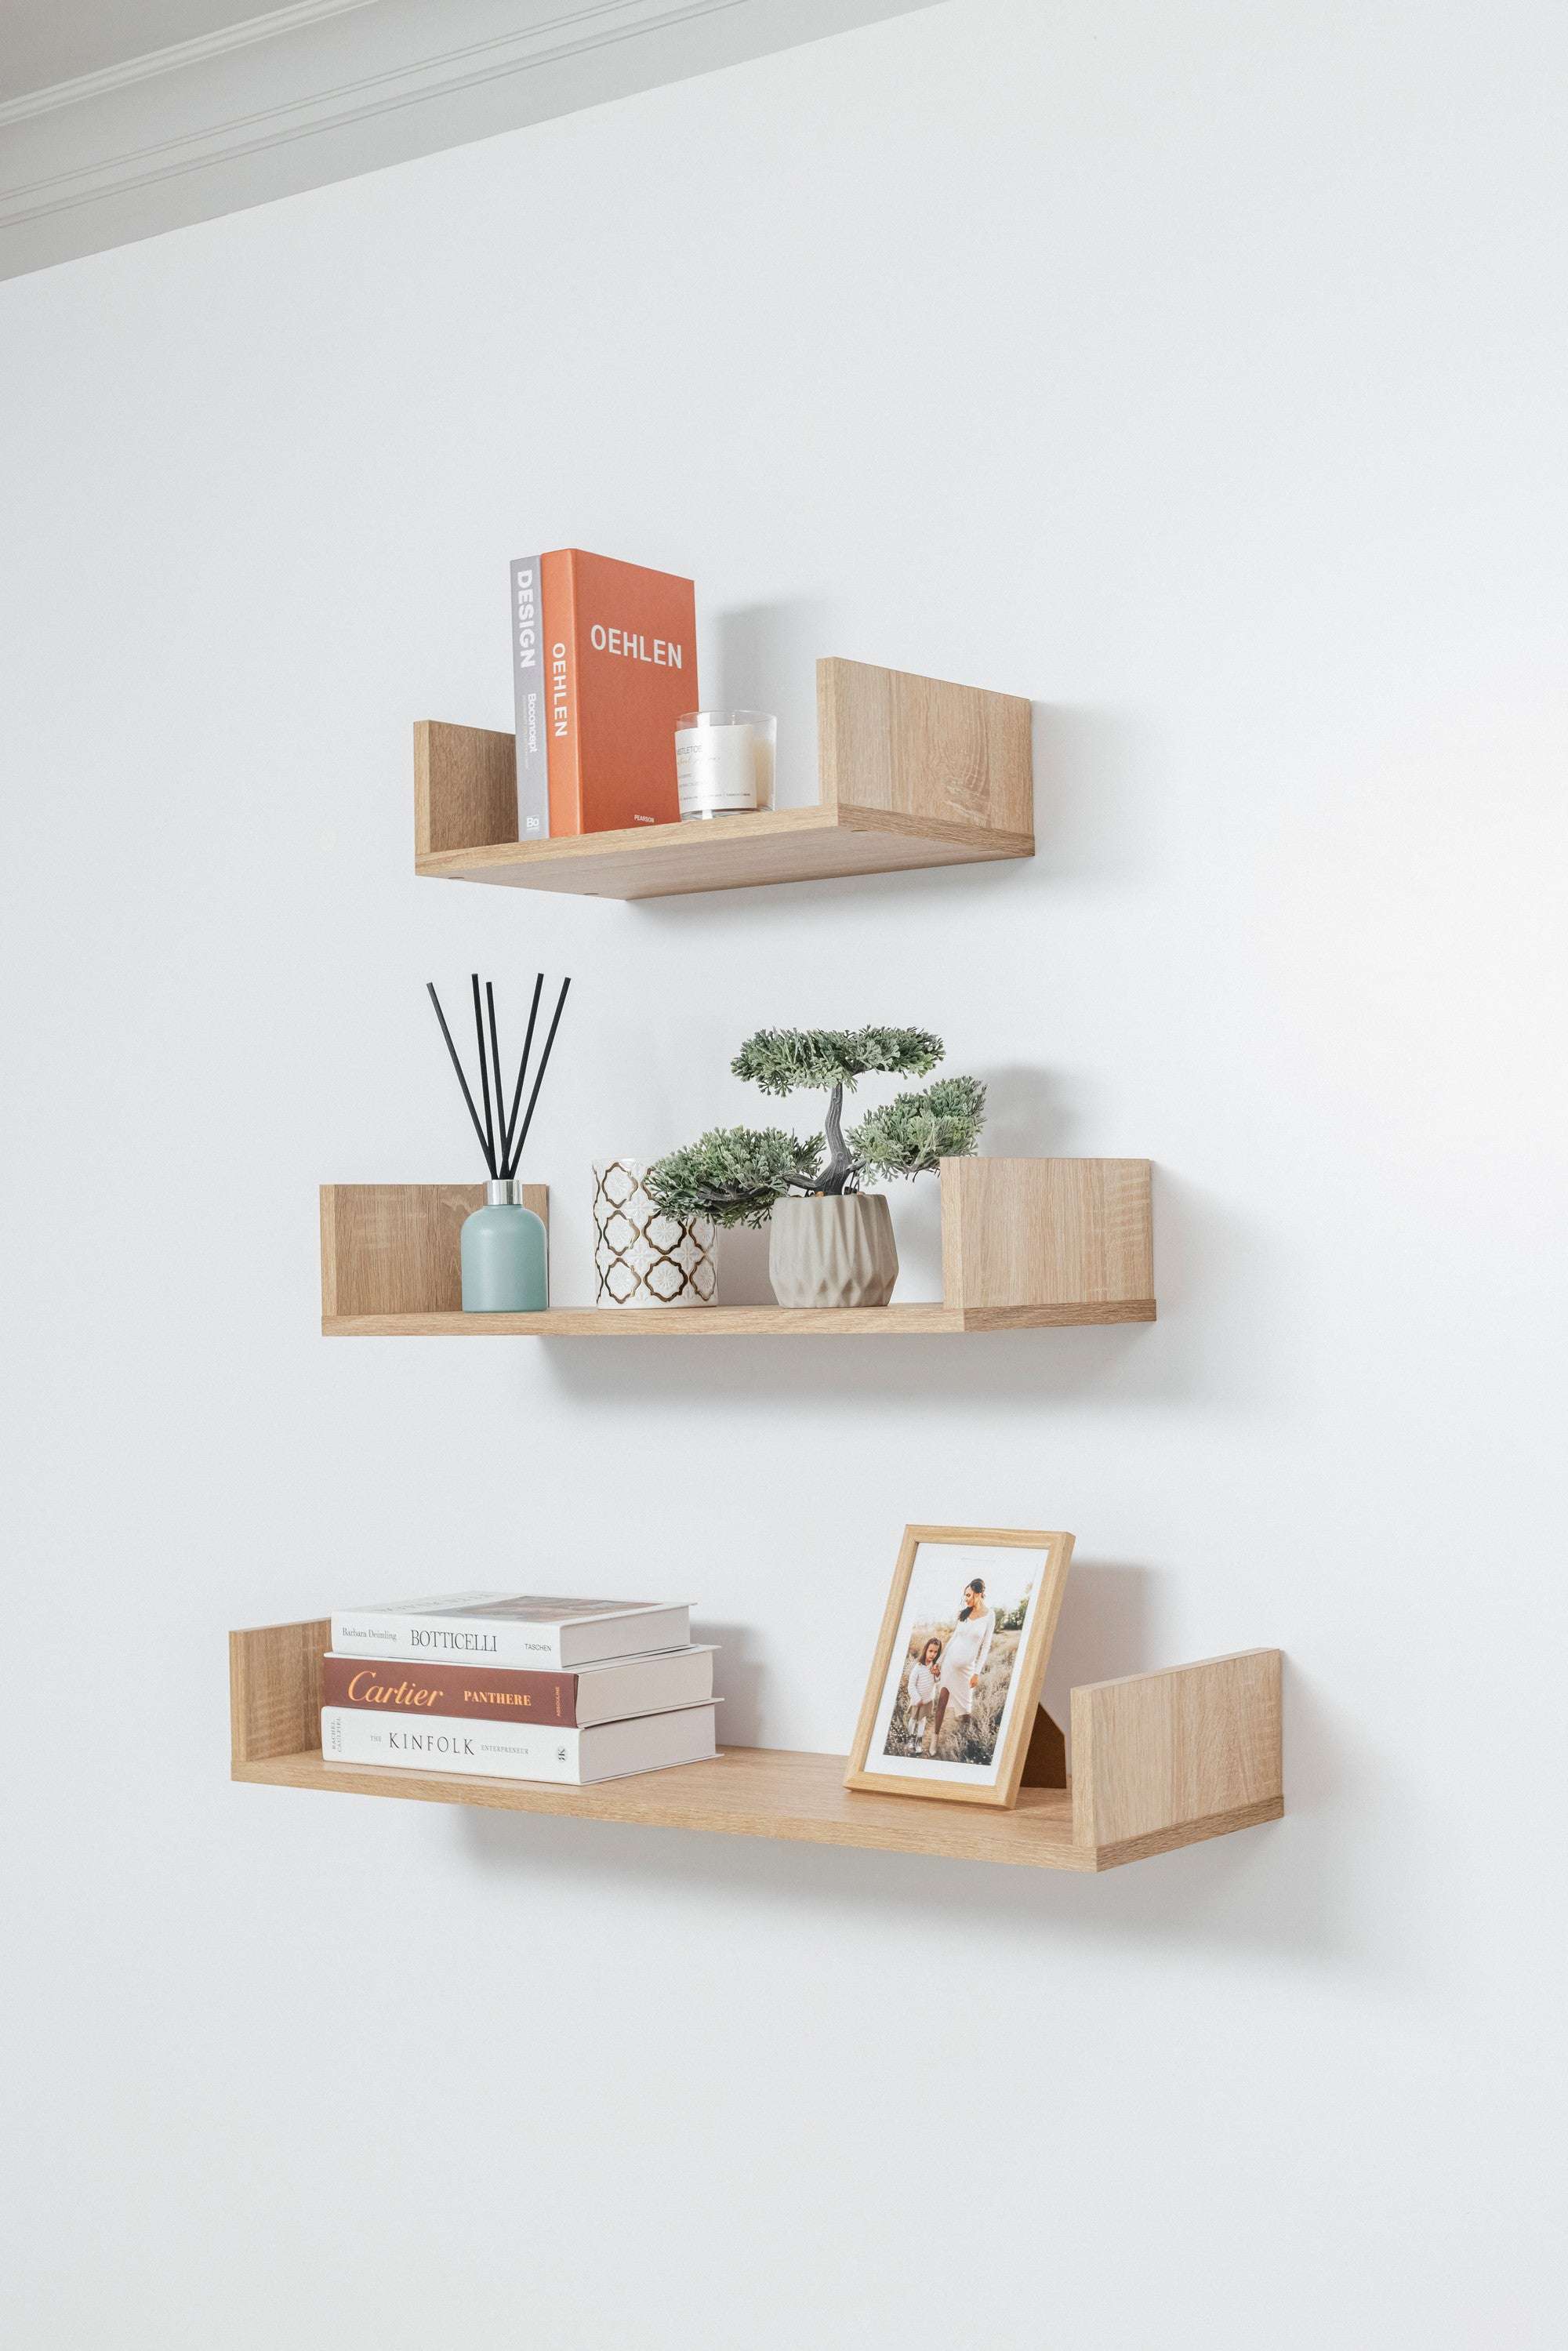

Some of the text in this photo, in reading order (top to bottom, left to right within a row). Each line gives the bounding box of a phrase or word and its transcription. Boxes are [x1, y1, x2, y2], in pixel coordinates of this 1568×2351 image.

[517, 570, 536, 669] DESIGN
[591, 624, 682, 669] OEHLEN
[553, 643, 568, 737] OEHLEN
[342, 1627, 552, 1652] Barbara Deimling BOTTICELLI TASCHEN
[348, 1671, 532, 1707] Cartier PANTHERE
[389, 1732, 475, 1756] KINFOLK
